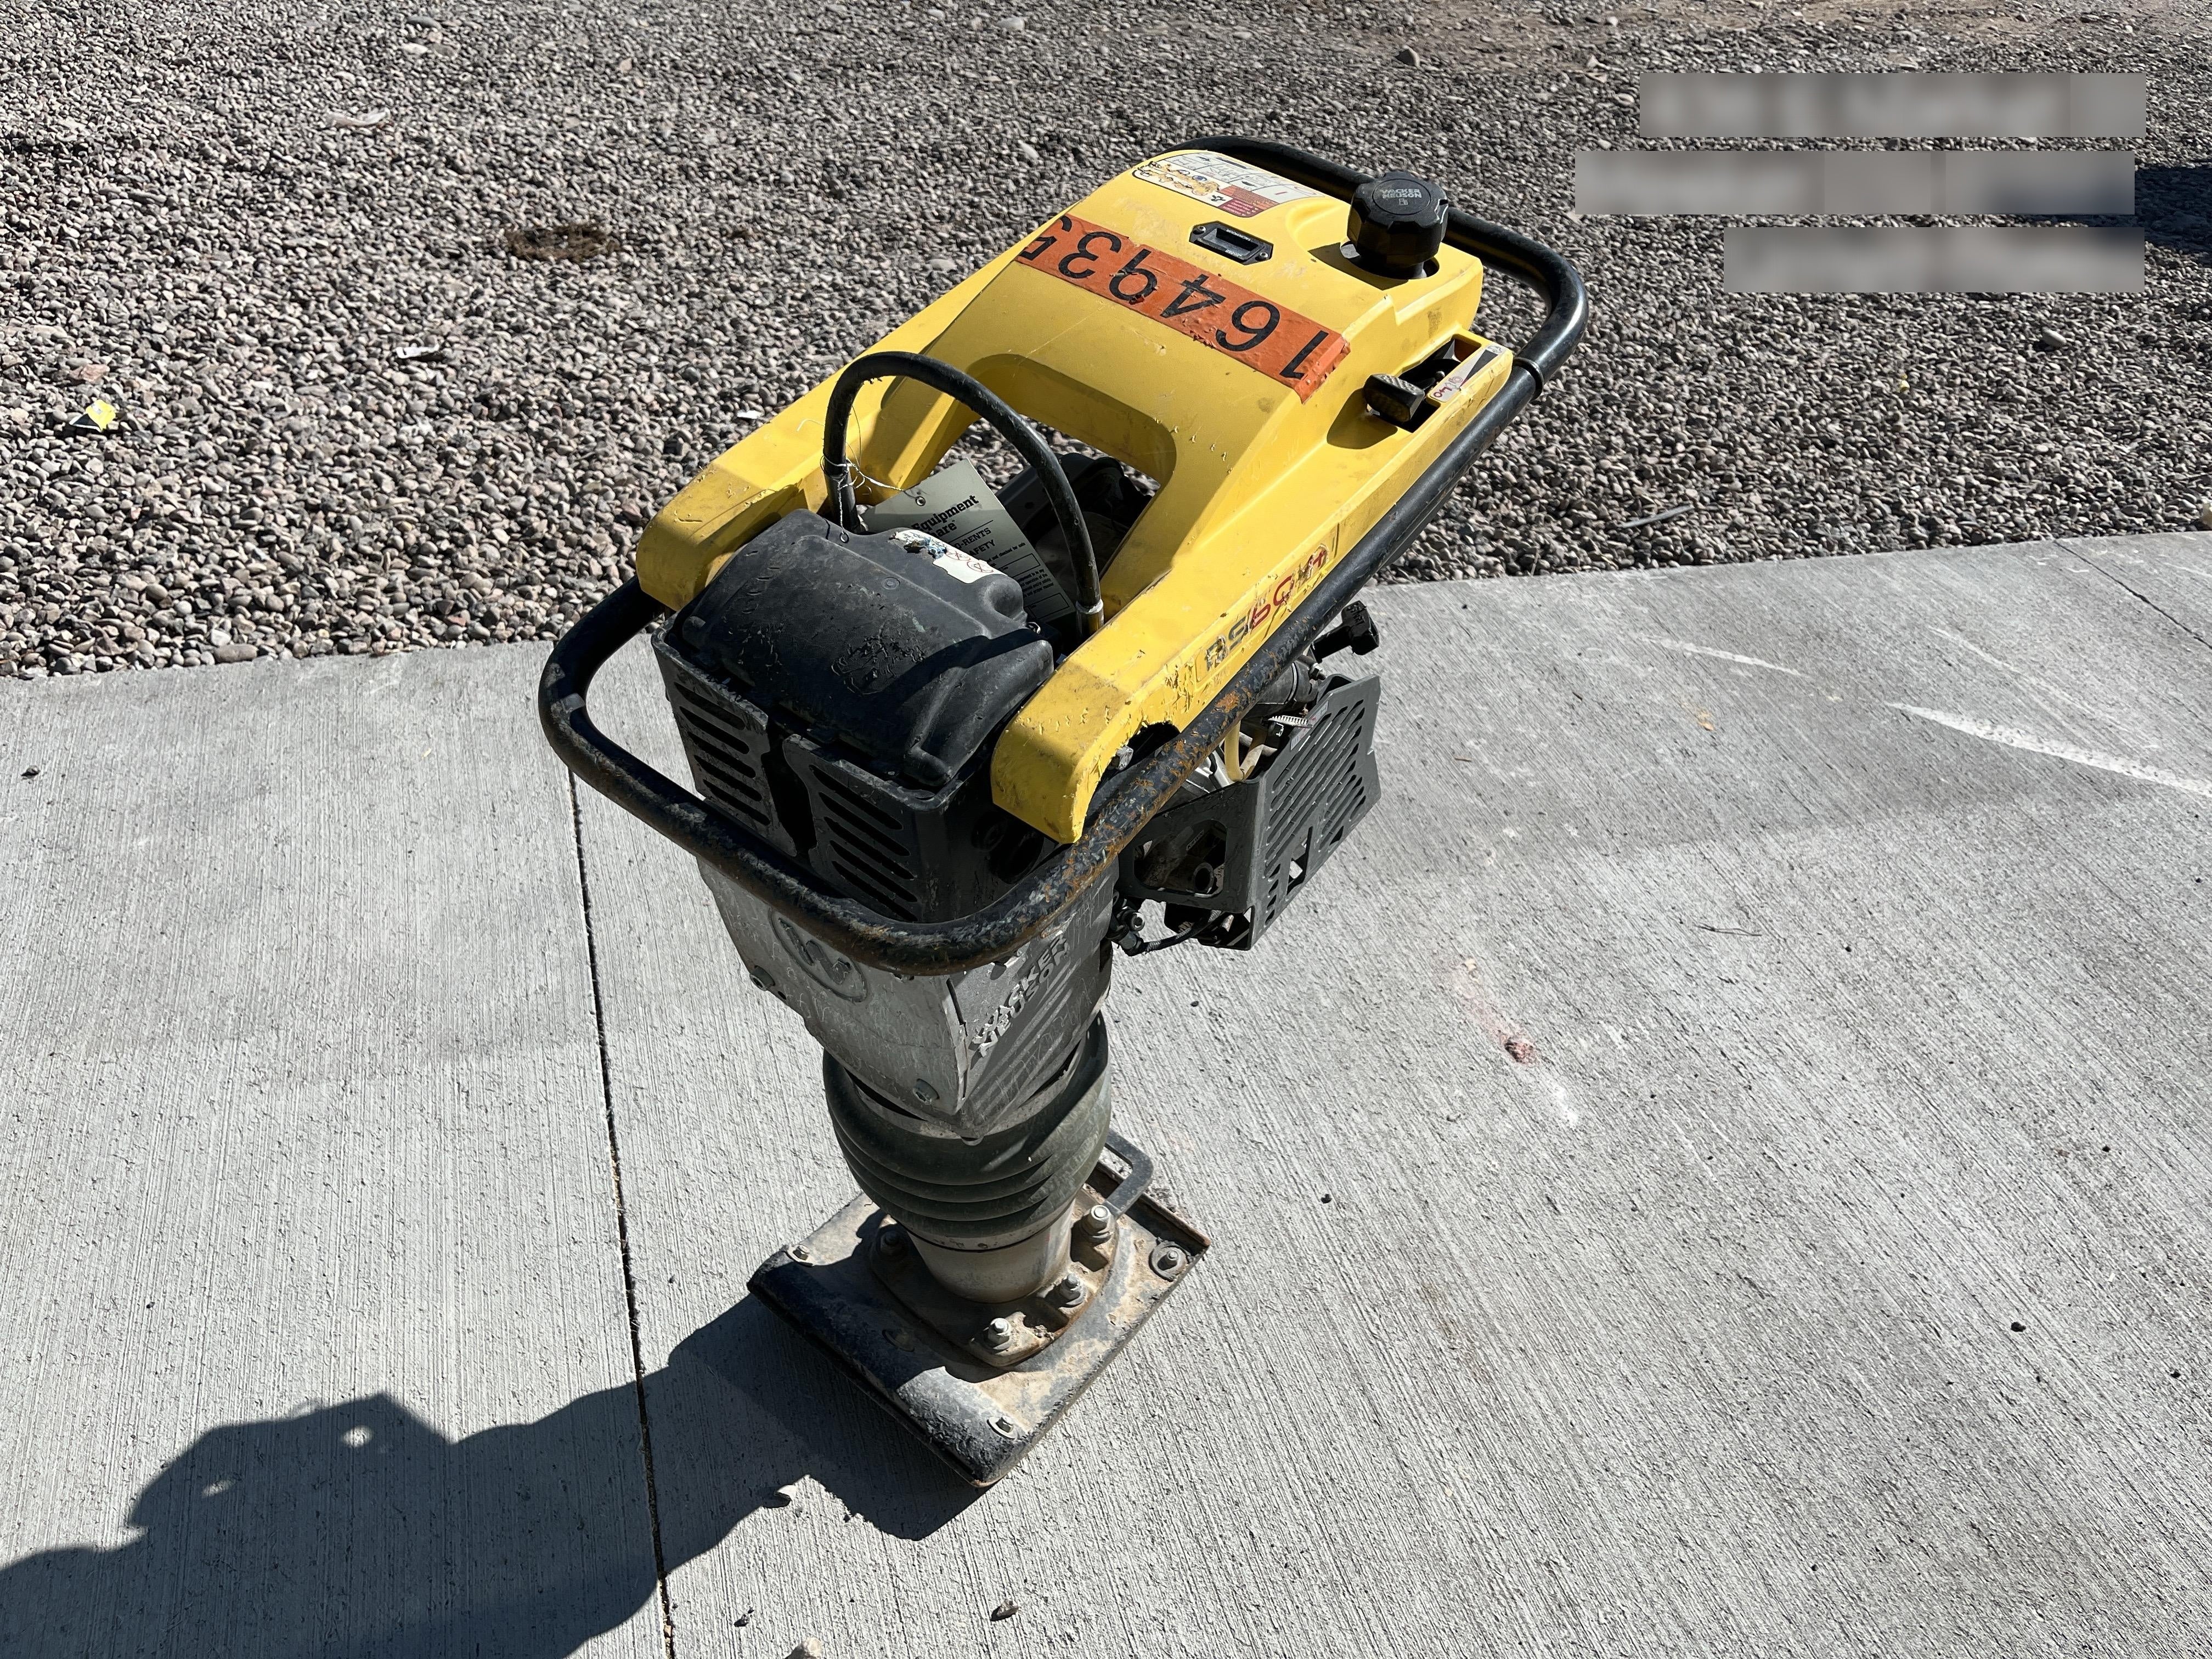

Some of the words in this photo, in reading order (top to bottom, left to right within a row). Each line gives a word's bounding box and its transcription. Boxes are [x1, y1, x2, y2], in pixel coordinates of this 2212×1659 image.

[911, 495, 979, 531] Equipment
[968, 539, 996, 557] AFETY
[971, 934, 1066, 1045] WACKER
[979, 939, 1069, 1058] NEUSON
